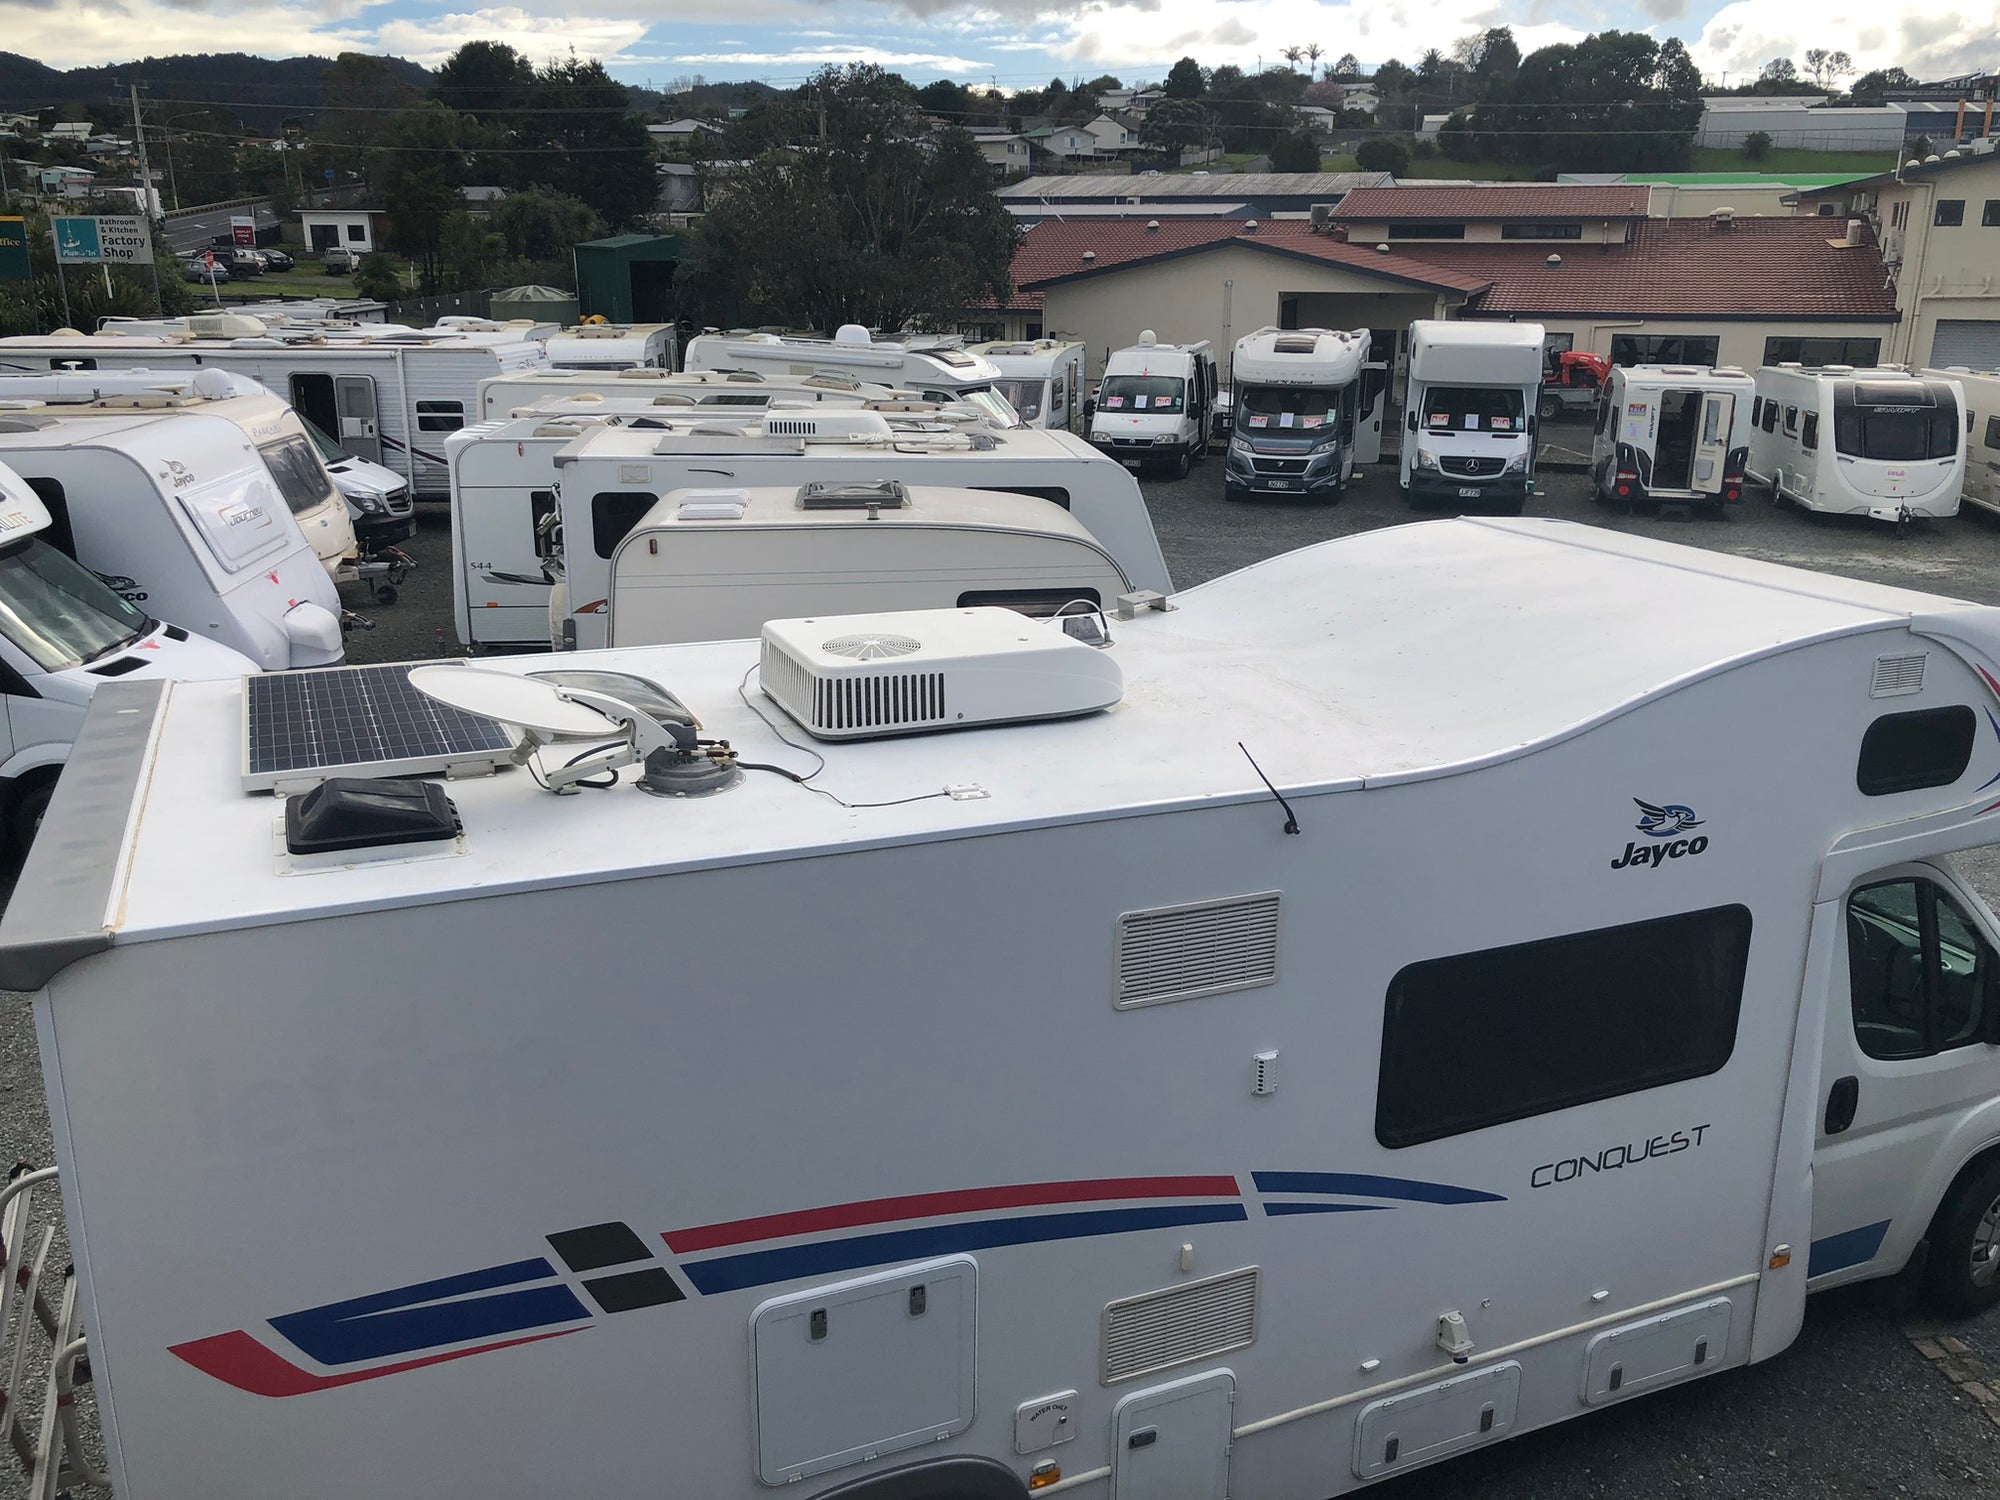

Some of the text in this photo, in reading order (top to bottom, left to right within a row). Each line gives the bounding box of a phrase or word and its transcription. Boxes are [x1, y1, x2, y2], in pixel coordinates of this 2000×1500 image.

[109, 226, 139, 234] Kitchen
[102, 235, 146, 248] Factory
[104, 247, 134, 259] Shop
[173, 473, 195, 488] Jayco
[229, 506, 264, 527] Journey
[1610, 836, 1709, 869] Jayco
[1530, 1123, 1711, 1188] CONQUEST
[1029, 1405, 1051, 1422] WATER
